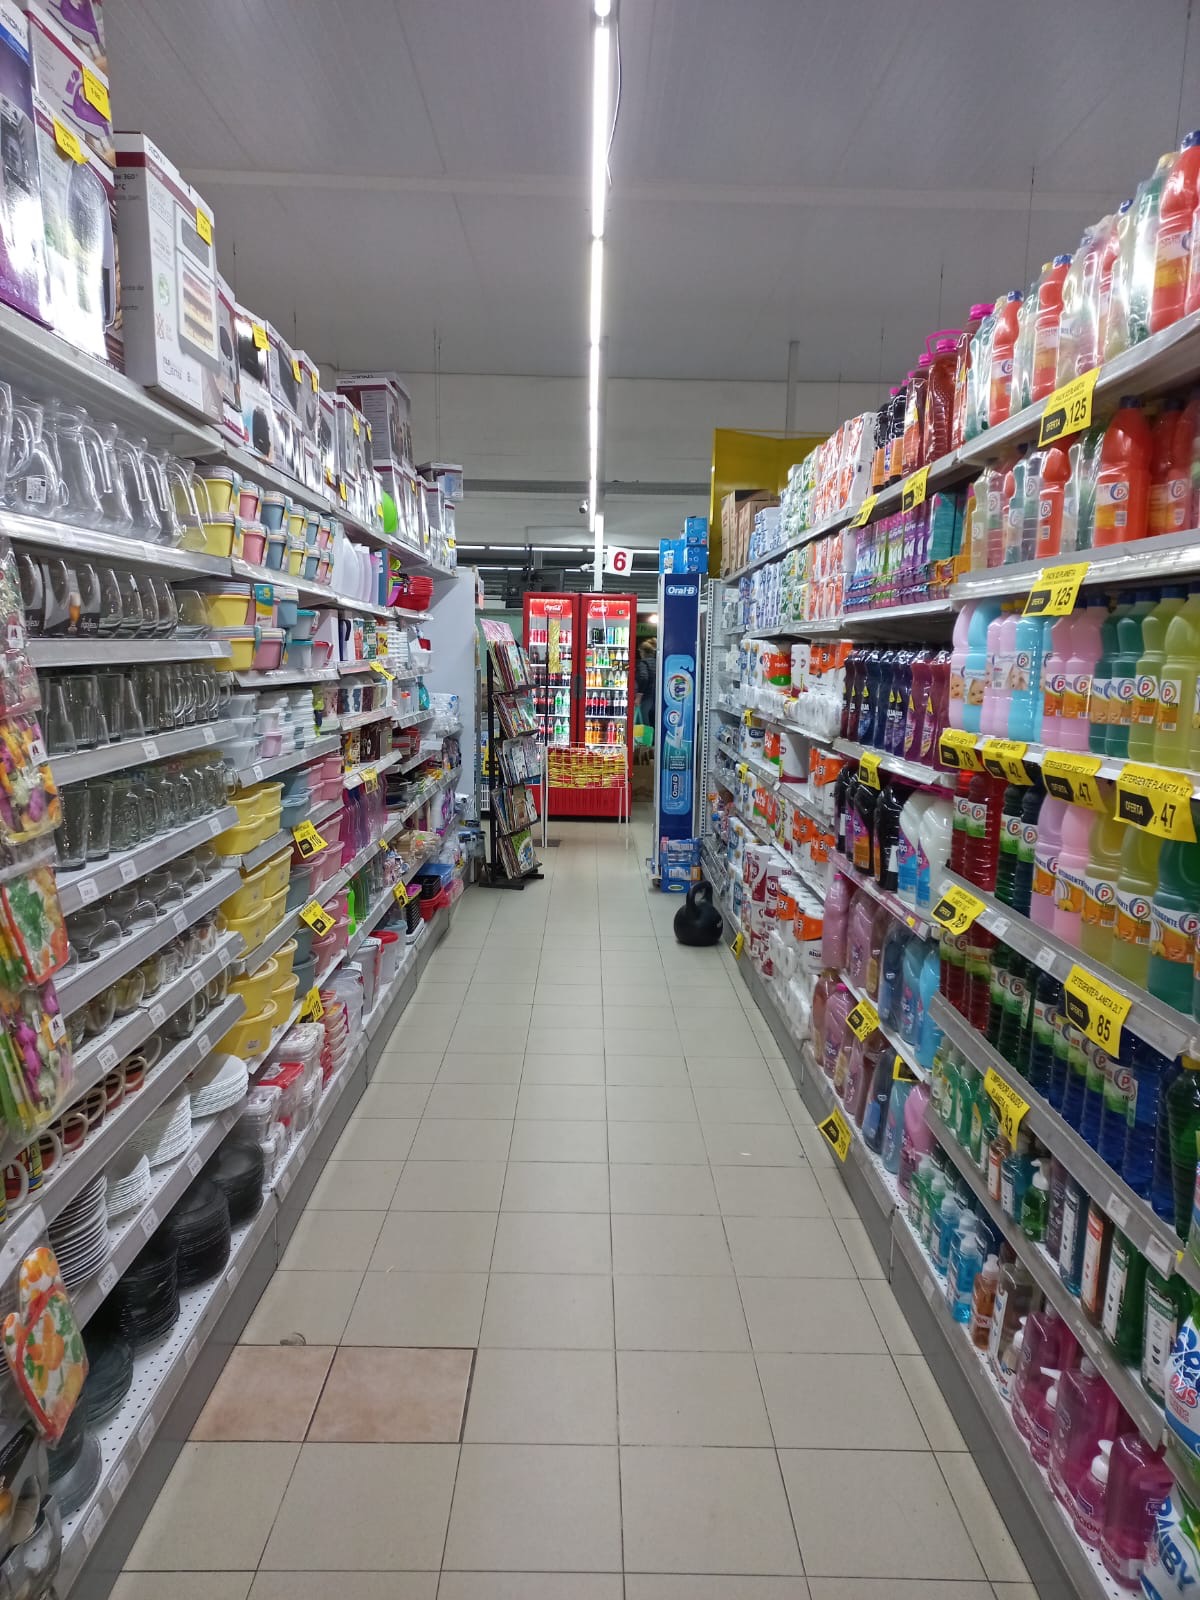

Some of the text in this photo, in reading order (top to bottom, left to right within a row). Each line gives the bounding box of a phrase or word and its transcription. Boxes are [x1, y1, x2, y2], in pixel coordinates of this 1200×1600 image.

[1070, 397, 1087, 423] 125
[613, 551, 627, 572] 6
[667, 586, 695, 596] Oral-B
[1055, 587, 1073, 606] 125
[1161, 802, 1177, 829] 47
[1097, 1014, 1111, 1042] 85
